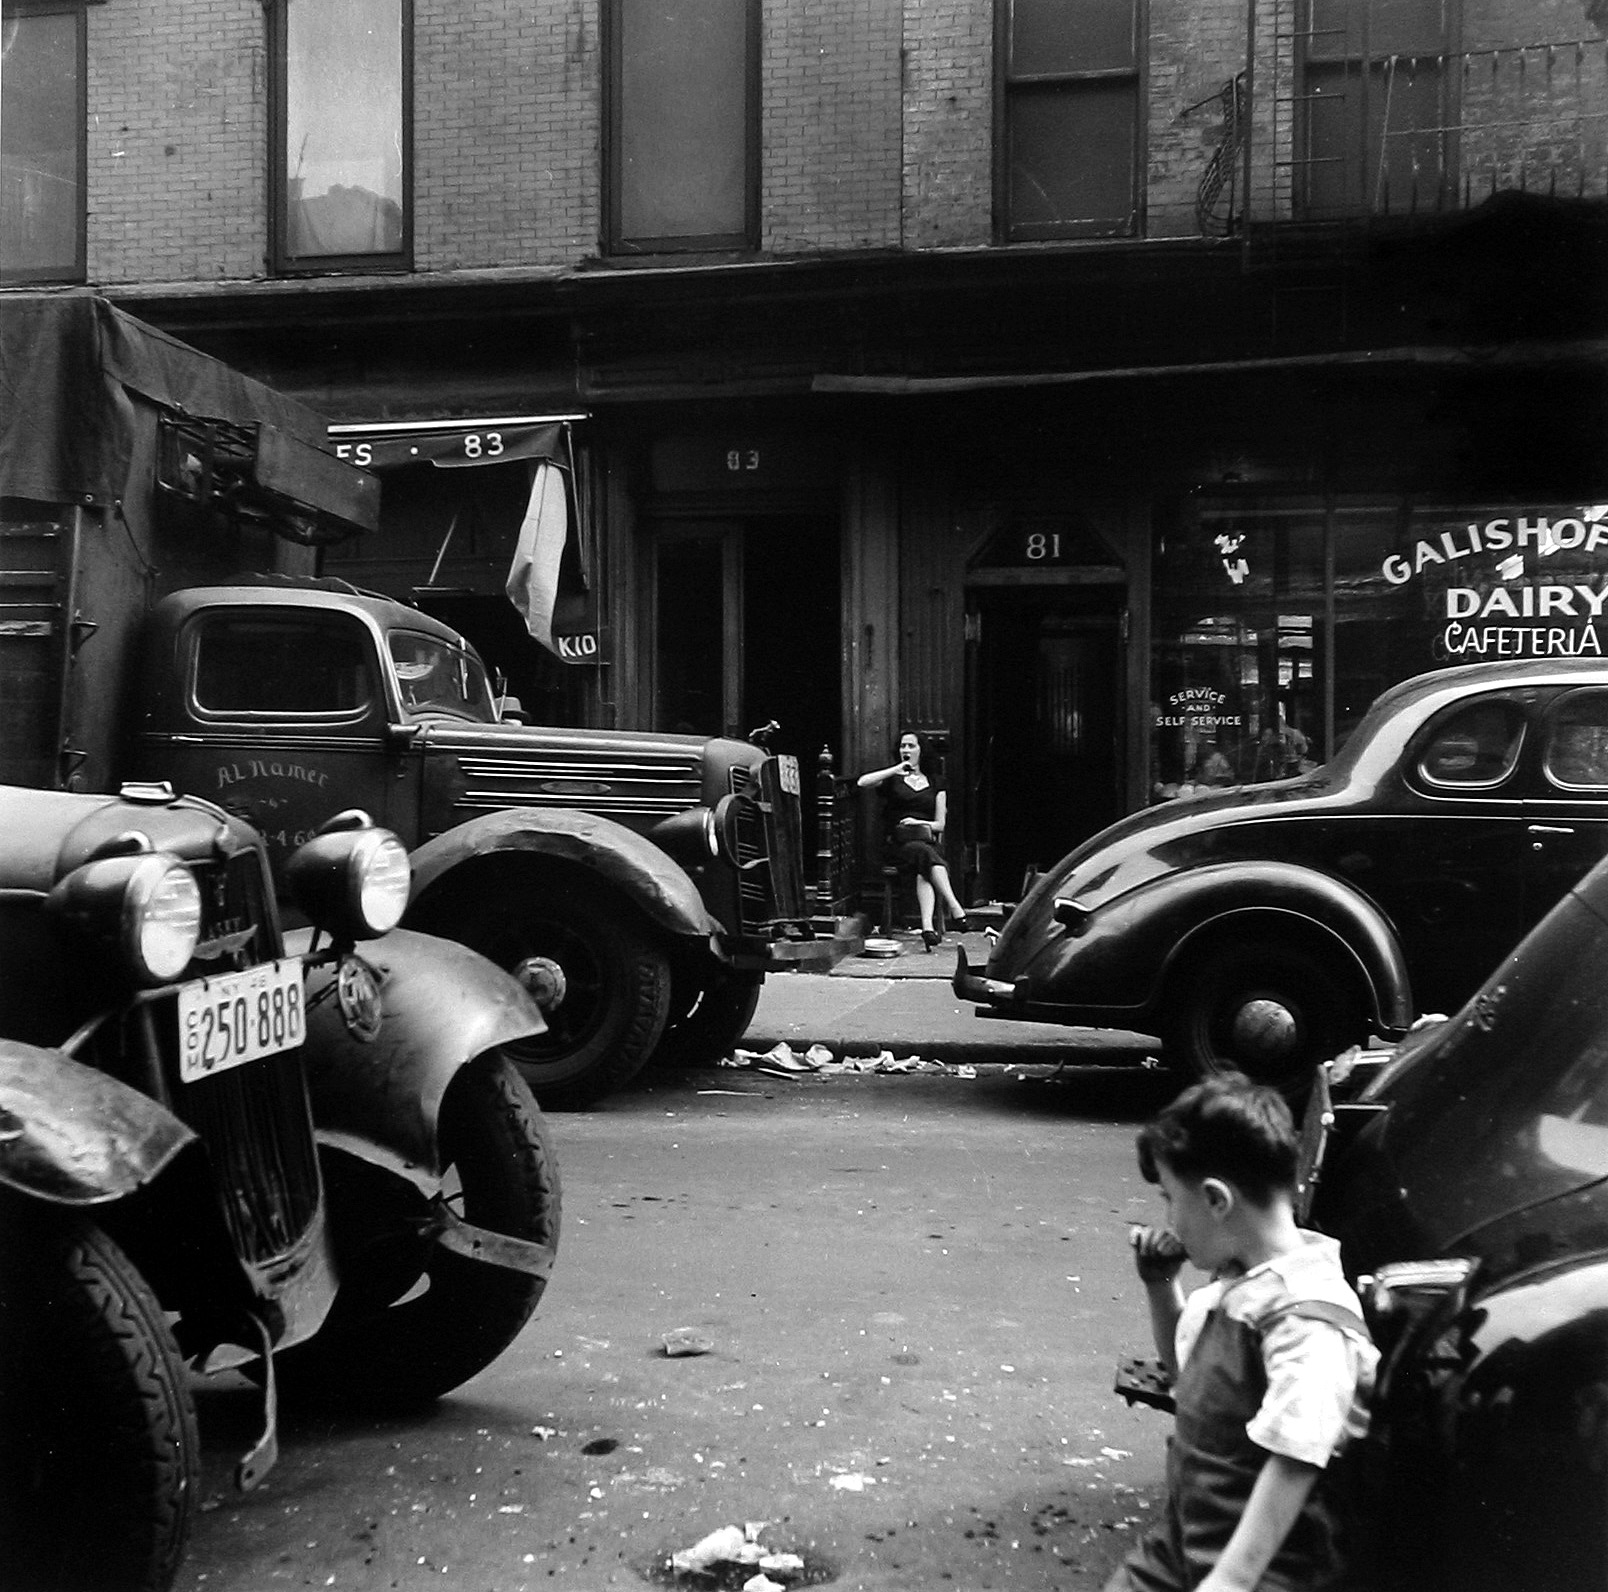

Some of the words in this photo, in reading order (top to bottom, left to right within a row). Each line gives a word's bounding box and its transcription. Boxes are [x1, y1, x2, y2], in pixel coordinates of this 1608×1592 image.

[464, 432, 504, 458] 83
[727, 450, 760, 470] 83
[1026, 533, 1060, 559] 81
[1446, 584, 1608, 619] DAIRY
[1444, 620, 1602, 655] CAFETERIA
[1169, 687, 1226, 706] SERVICE
[1186, 704, 1211, 712] AND
[1156, 716, 1186, 726] SELF
[1191, 716, 1241, 726] SERVICE
